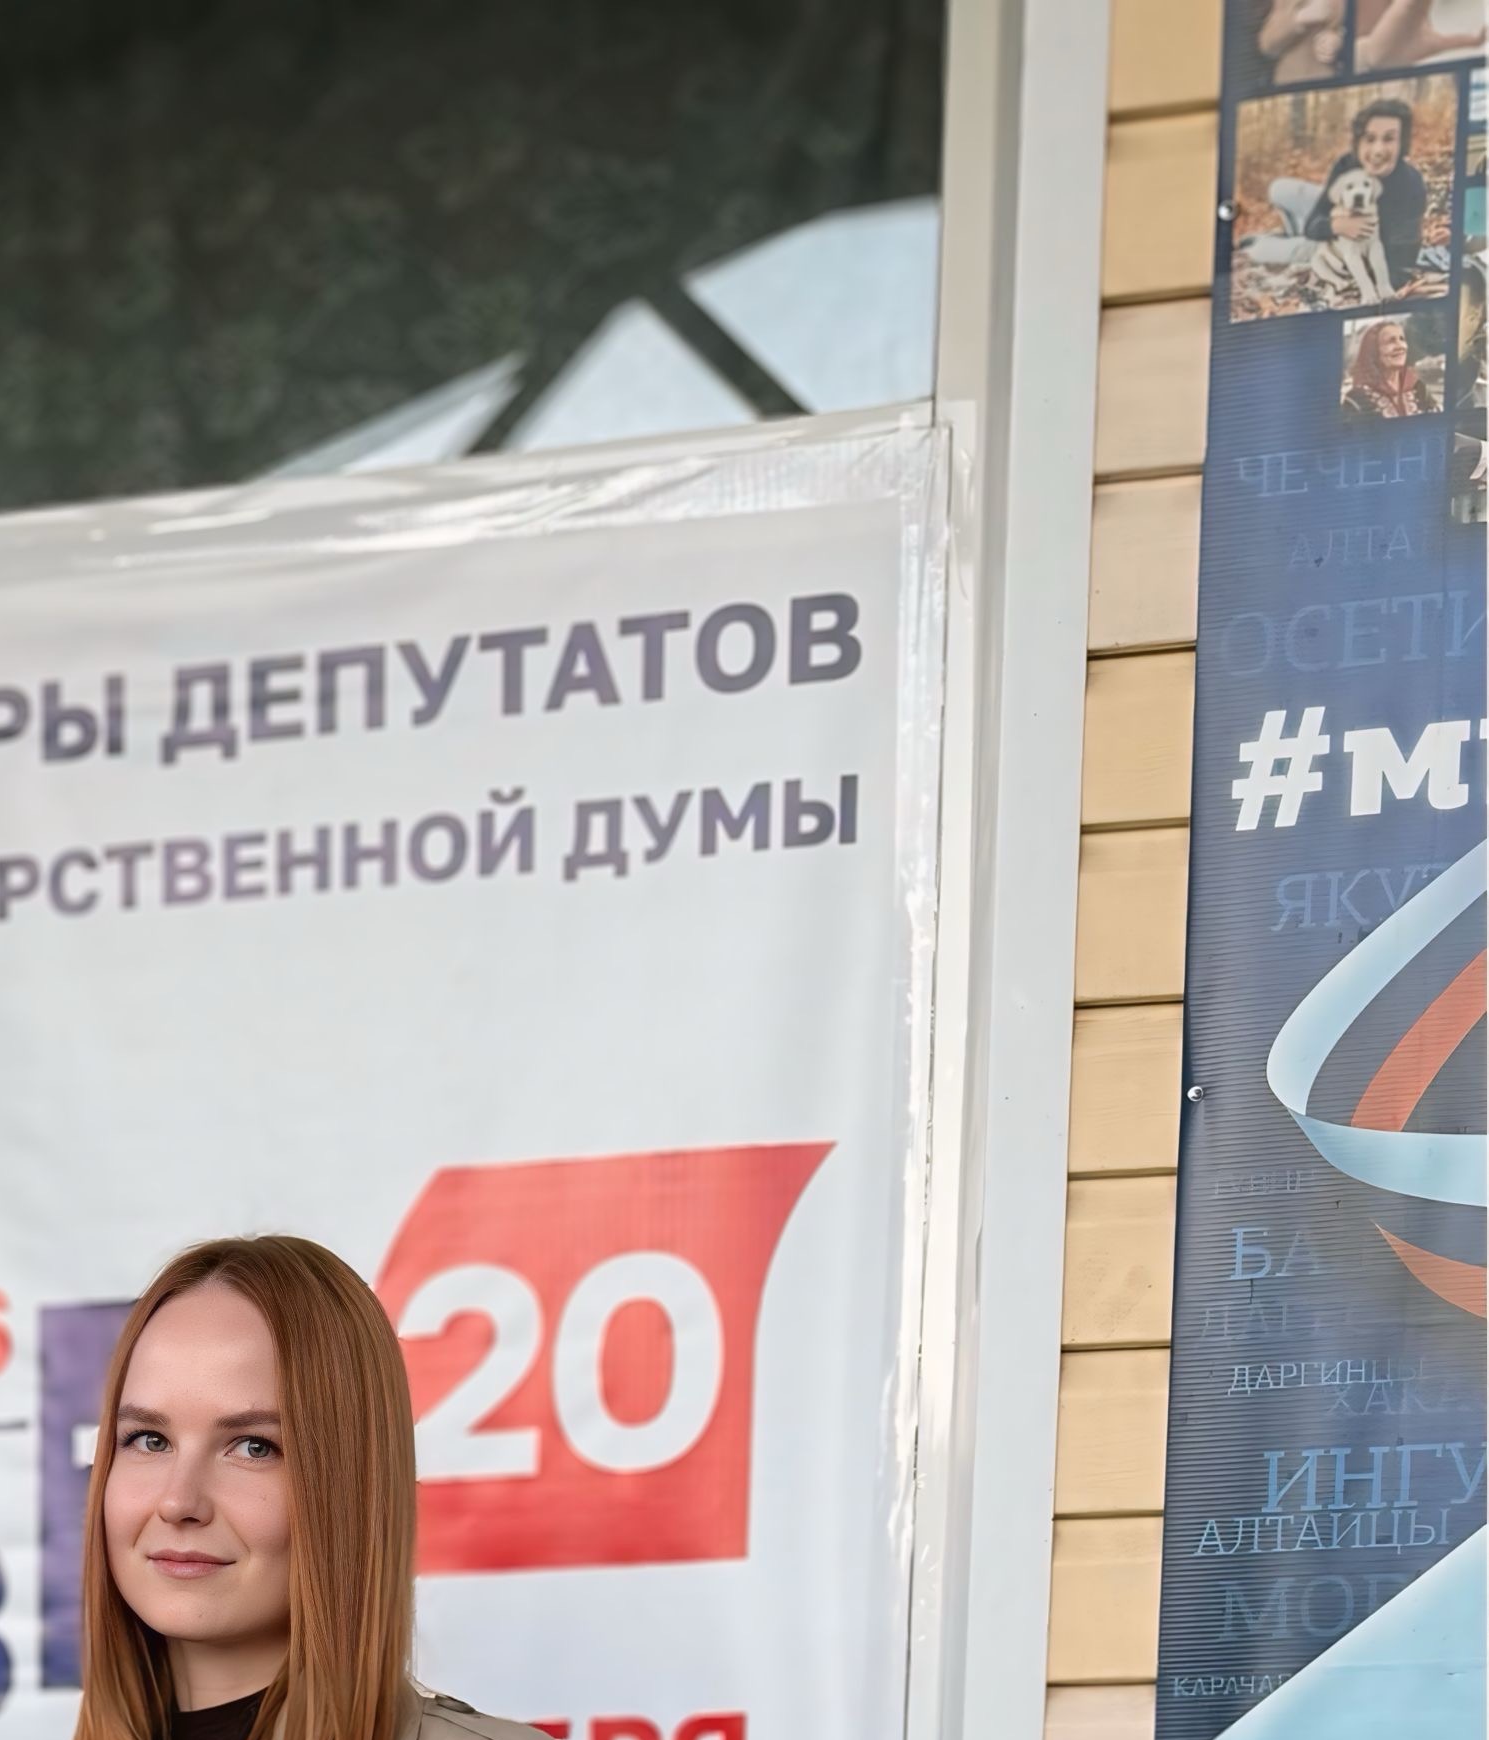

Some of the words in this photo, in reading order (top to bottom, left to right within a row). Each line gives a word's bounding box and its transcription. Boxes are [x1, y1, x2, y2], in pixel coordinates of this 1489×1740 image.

[159, 591, 865, 766] ДЕПУТАТОВ
[563, 773, 861, 881] ДУМЫ
[397, 1250, 725, 1481] 20
